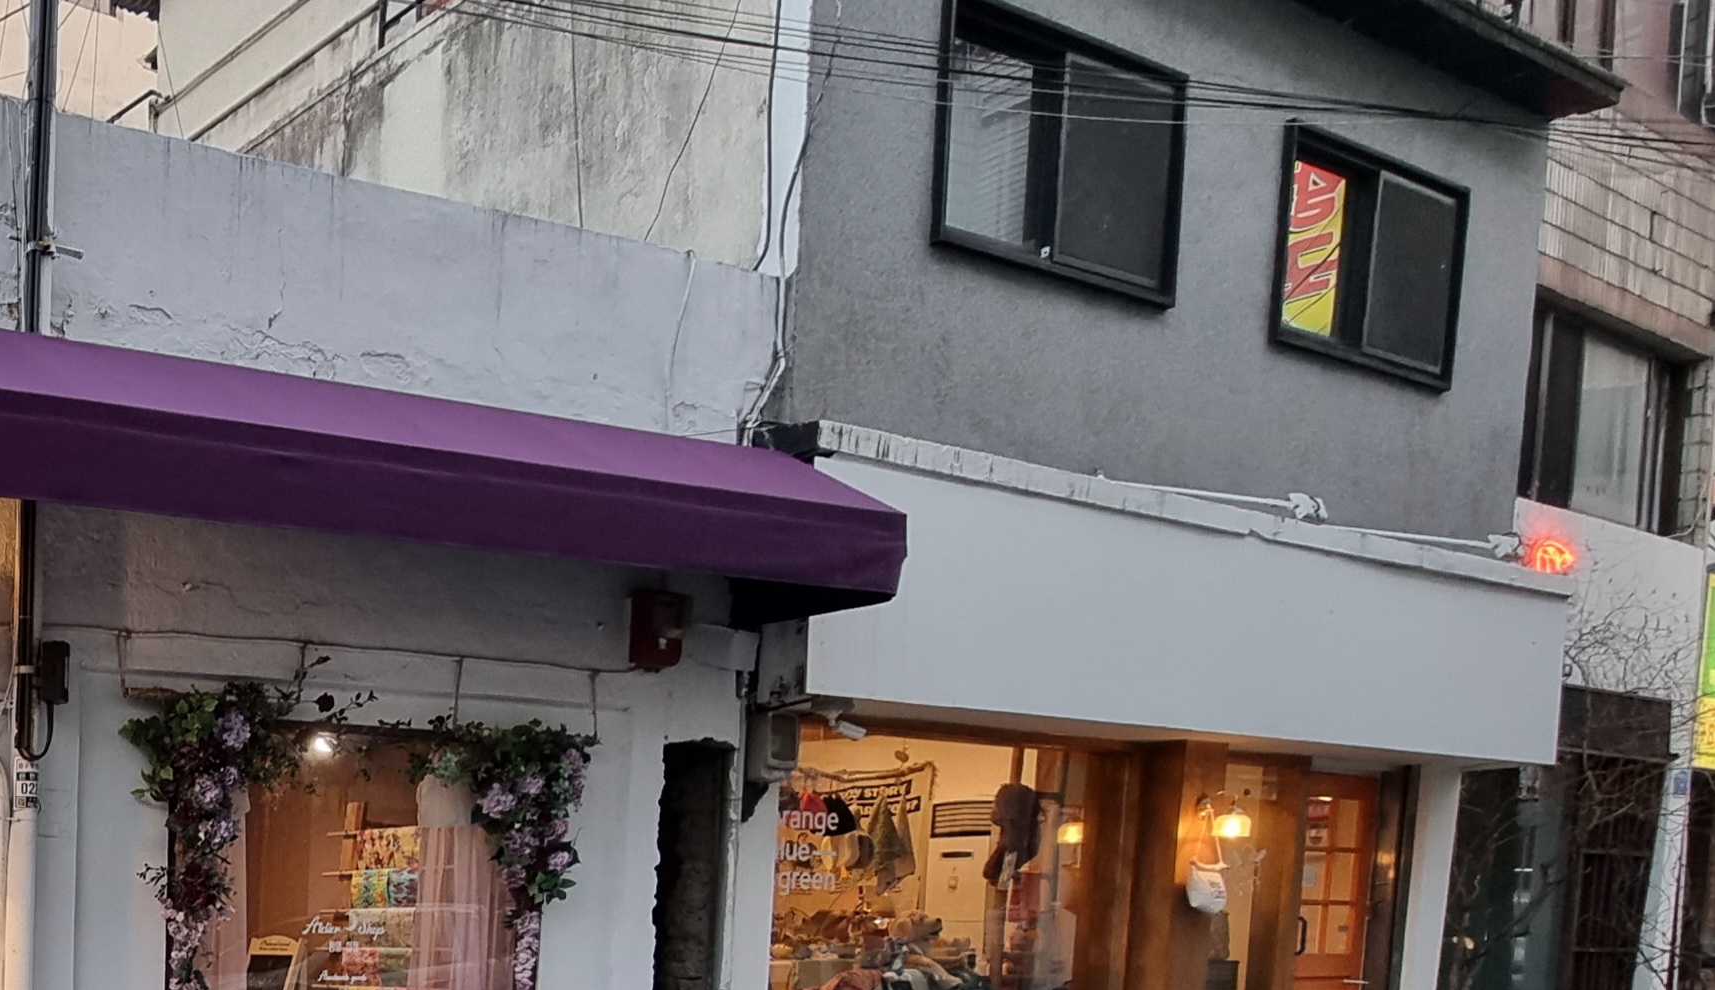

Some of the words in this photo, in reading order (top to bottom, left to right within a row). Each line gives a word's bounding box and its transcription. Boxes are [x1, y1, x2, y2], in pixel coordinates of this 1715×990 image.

[781, 809, 839, 836] range
[777, 870, 836, 896] green
[301, 915, 342, 936] Atelier
[357, 921, 386, 941] Shop
